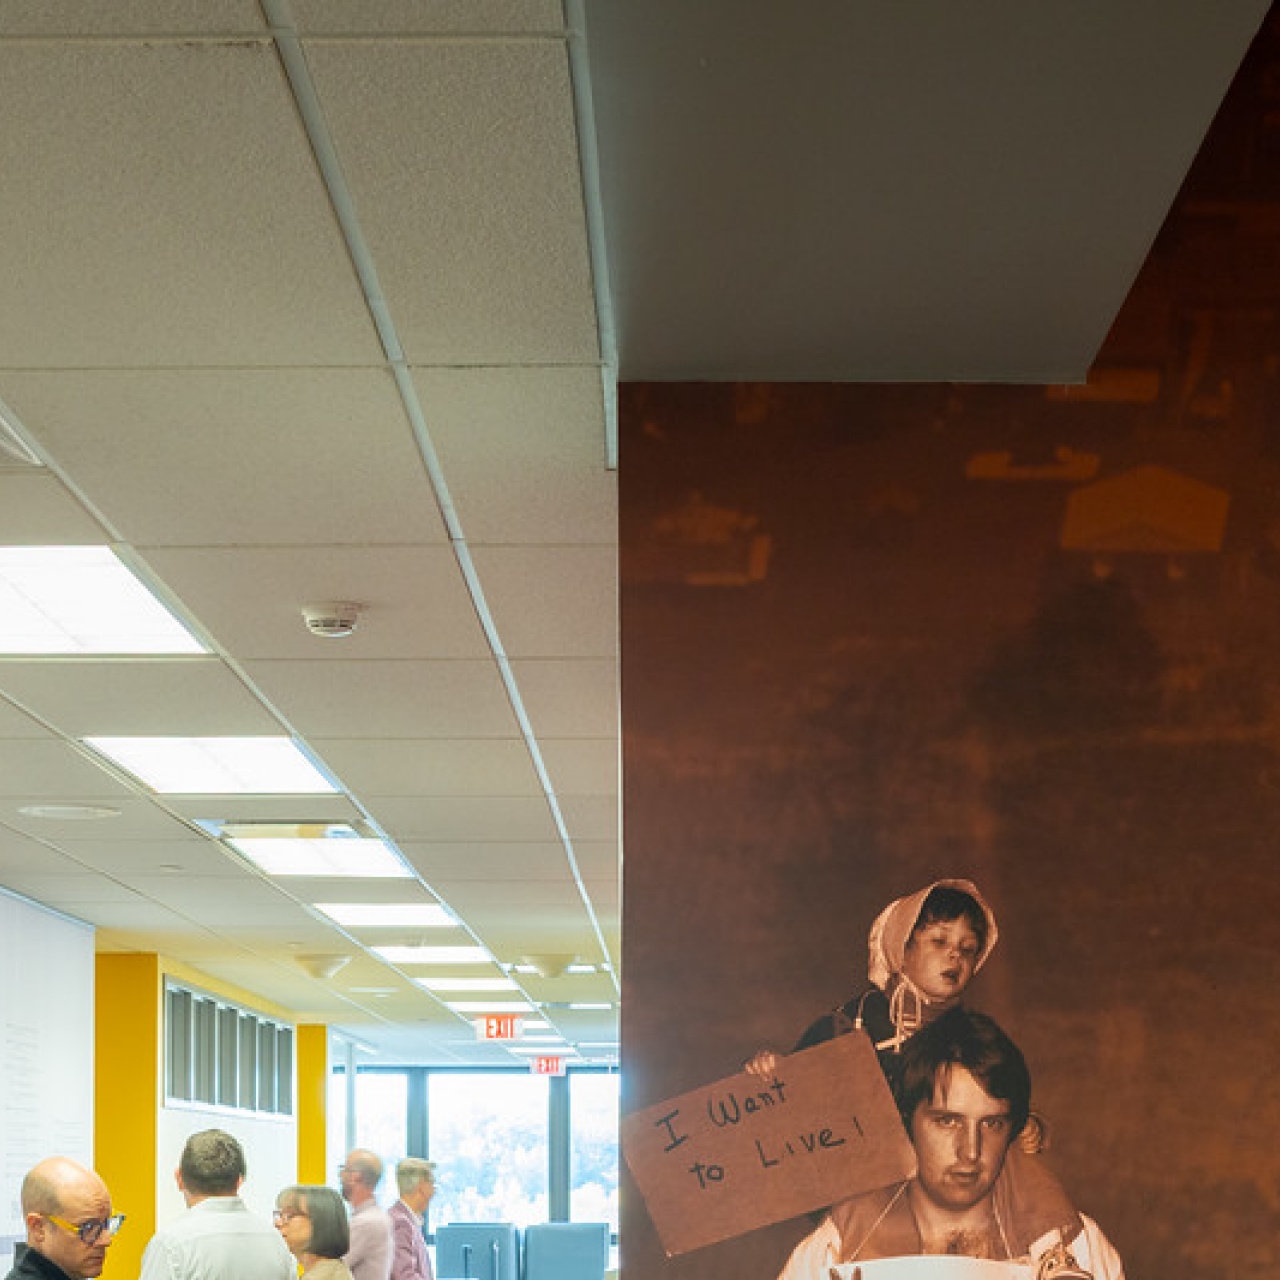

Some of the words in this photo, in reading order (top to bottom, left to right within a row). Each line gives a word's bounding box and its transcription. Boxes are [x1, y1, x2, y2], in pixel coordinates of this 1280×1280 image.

[486, 1016, 514, 1039] EXIT
[537, 1056, 559, 1075] EXIT
[655, 1109, 689, 1153] I
[708, 1076, 787, 1128] Want
[688, 1161, 725, 1189] to
